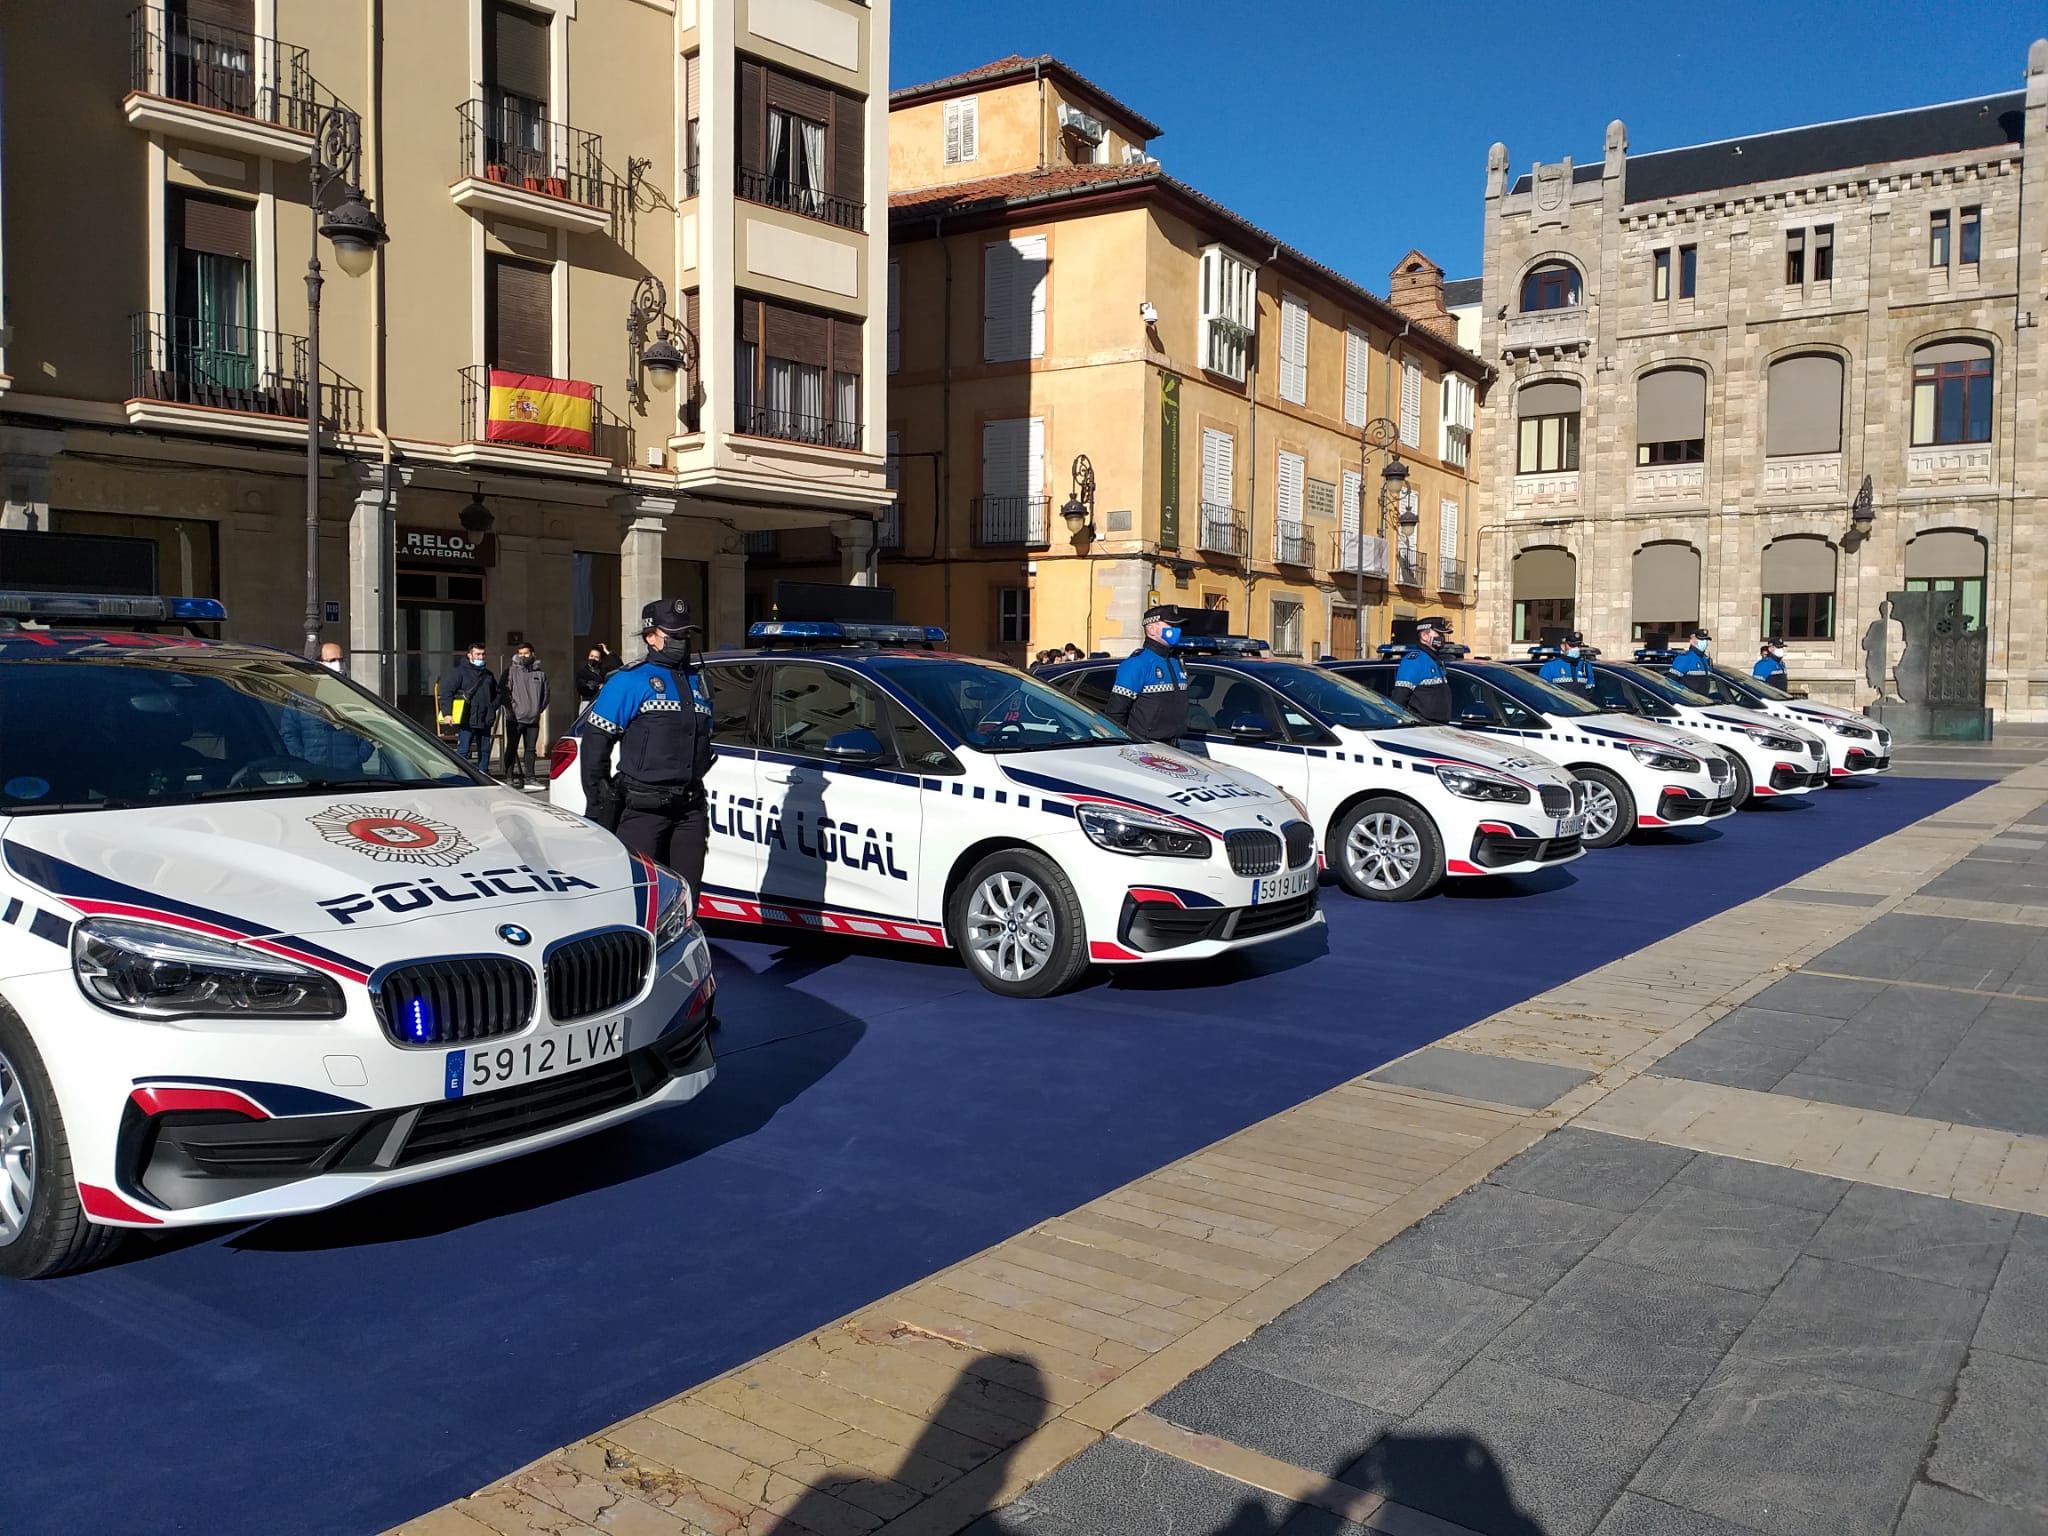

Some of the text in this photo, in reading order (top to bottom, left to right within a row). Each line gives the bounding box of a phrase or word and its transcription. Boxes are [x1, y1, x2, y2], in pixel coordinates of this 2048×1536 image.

[407, 533, 476, 551] RELOJ
[413, 548, 475, 560] CATEDRAL
[710, 790, 908, 881] LICÍA LOCAL
[1260, 873, 1309, 900] 5919 LVX
[472, 1021, 618, 1086] 5912 LVX
[451, 1078, 458, 1088] E
